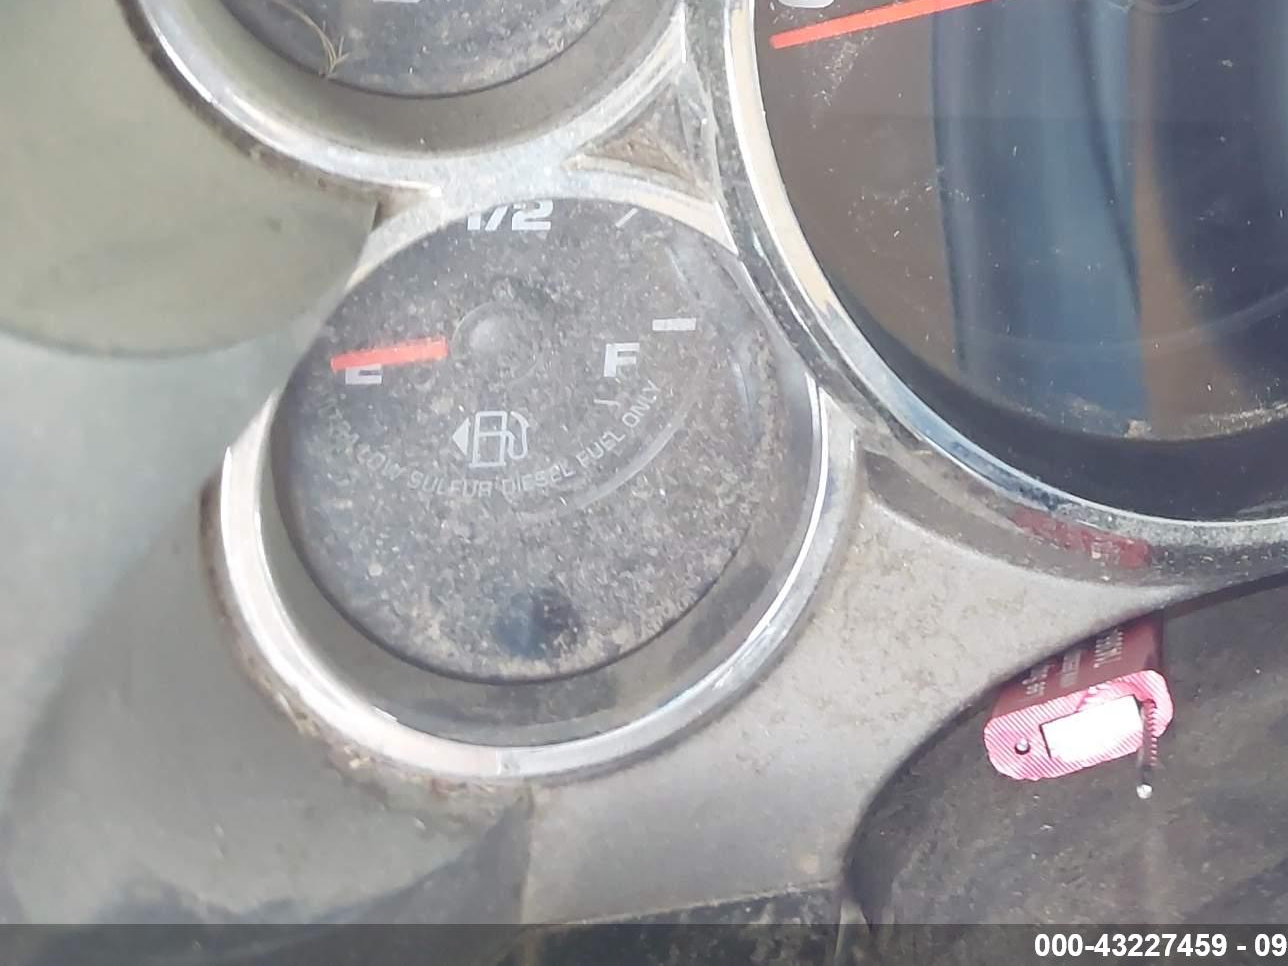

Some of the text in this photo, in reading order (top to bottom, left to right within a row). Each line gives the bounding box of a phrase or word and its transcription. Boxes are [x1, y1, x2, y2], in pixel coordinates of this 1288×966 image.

[604, 342, 640, 377] F
[407, 471, 493, 498] SULFUR
[502, 462, 577, 496] DIESEL
[576, 430, 627, 468] FUEL
[622, 379, 662, 427] ONLY
